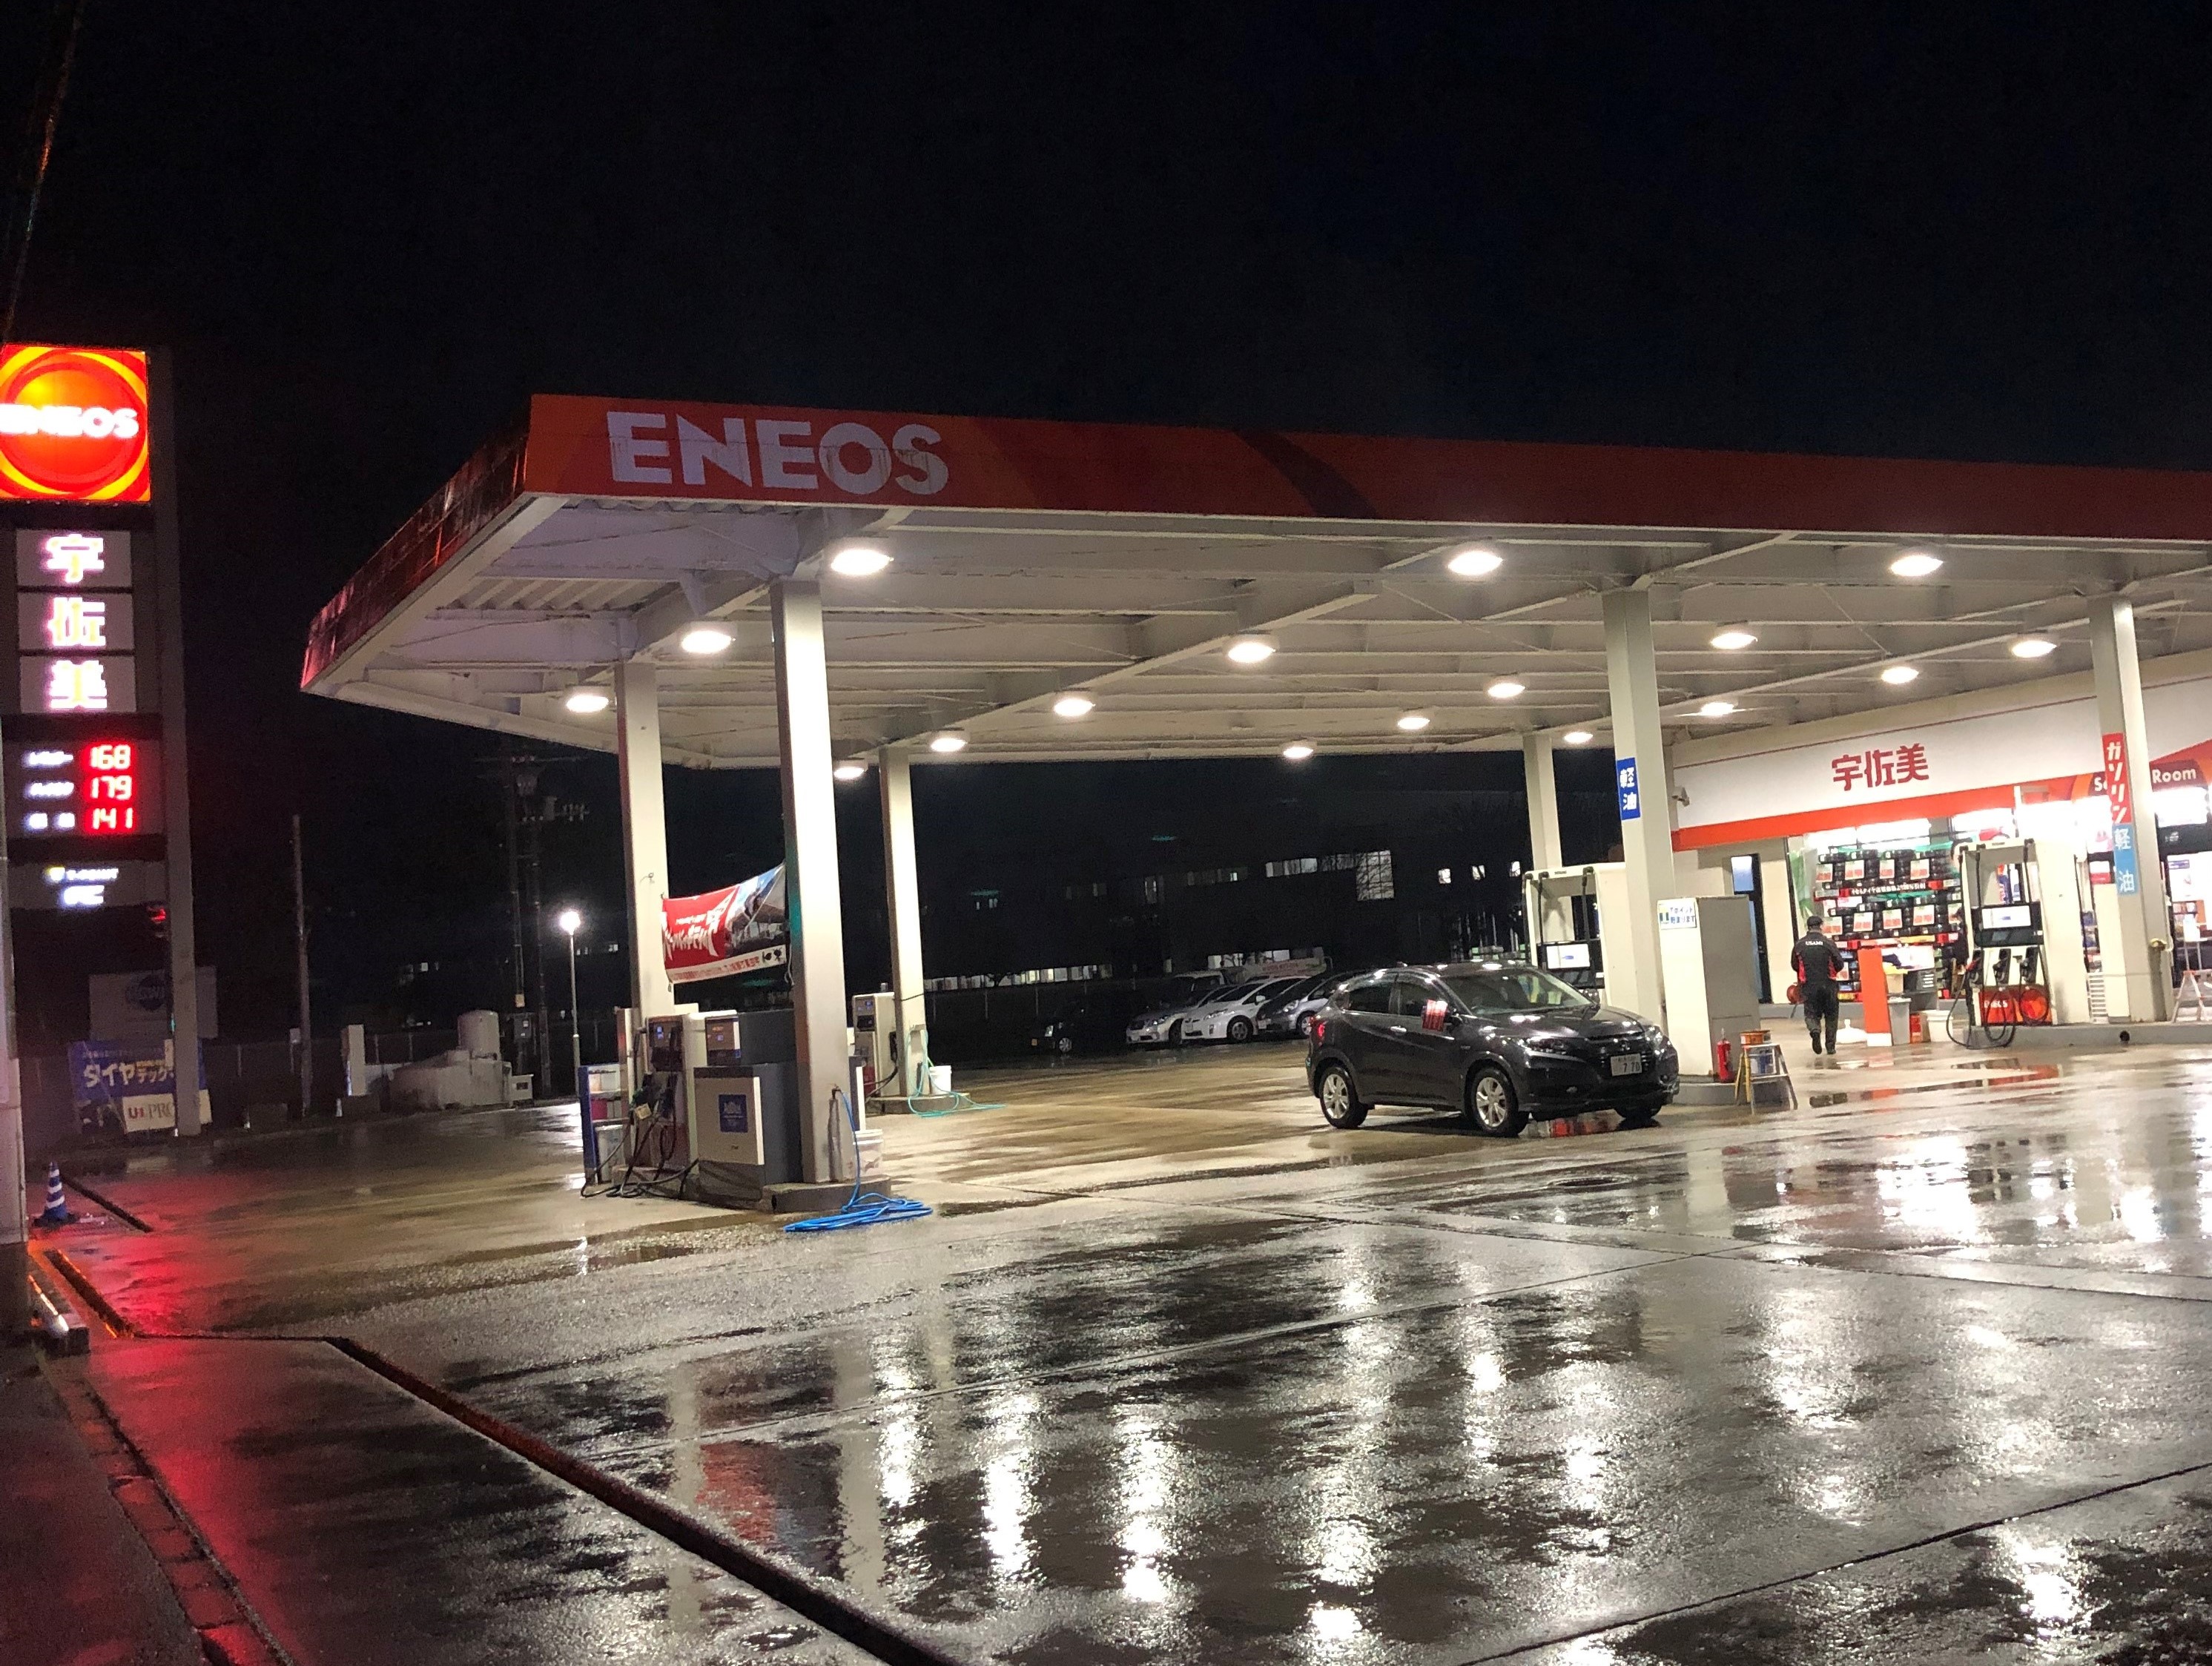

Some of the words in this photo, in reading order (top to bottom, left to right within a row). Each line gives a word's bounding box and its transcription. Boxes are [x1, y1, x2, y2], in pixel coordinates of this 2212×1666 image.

[607, 411, 949, 495] ENEOS
[90, 744, 131, 770] 168
[1832, 743, 1929, 792] 宇佐美
[2152, 768, 2196, 784] Room
[90, 776, 133, 801] 179
[1620, 767, 1637, 810] 軽油
[2107, 741, 2127, 824] ガソリン
[2114, 828, 2136, 892] 軽油
